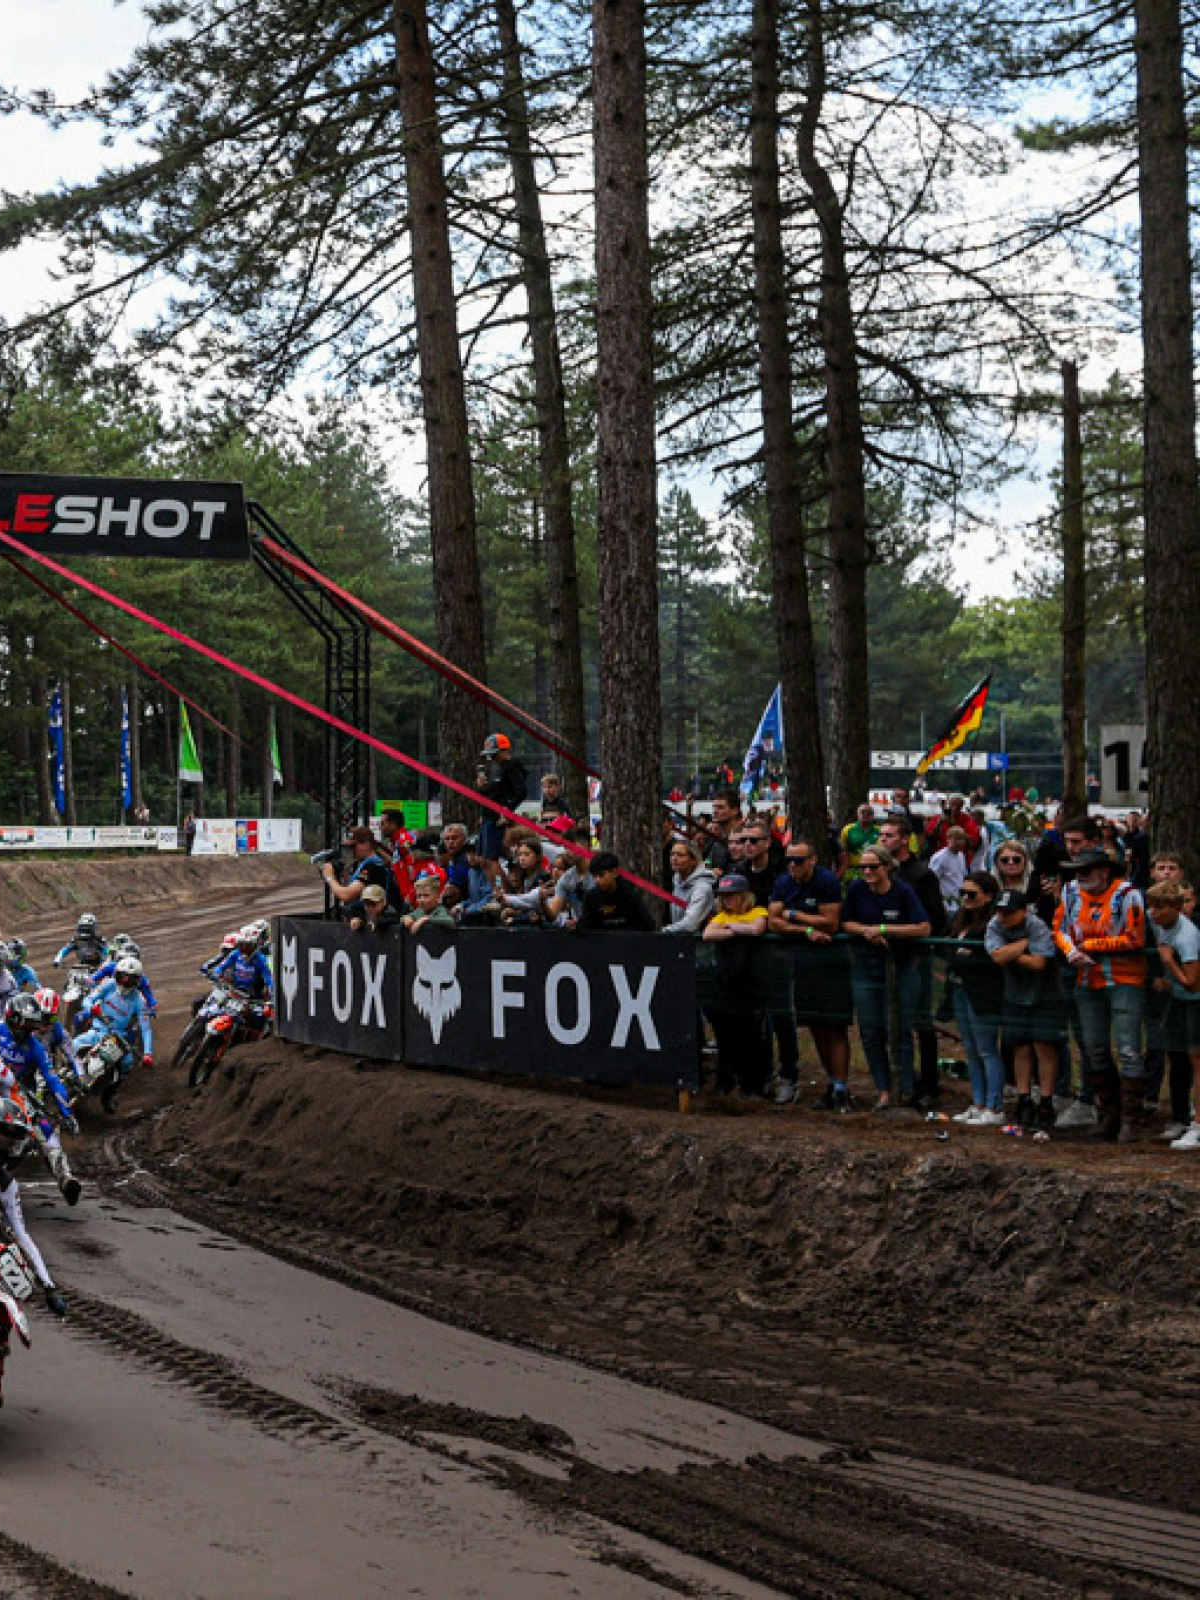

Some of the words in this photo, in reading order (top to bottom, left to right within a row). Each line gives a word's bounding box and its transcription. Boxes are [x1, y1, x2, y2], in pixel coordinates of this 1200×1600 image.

[877, 752, 980, 768] STRT
[1104, 741, 1148, 792] 1
[307, 946, 387, 1028] FOX
[490, 959, 662, 1051] FOX
